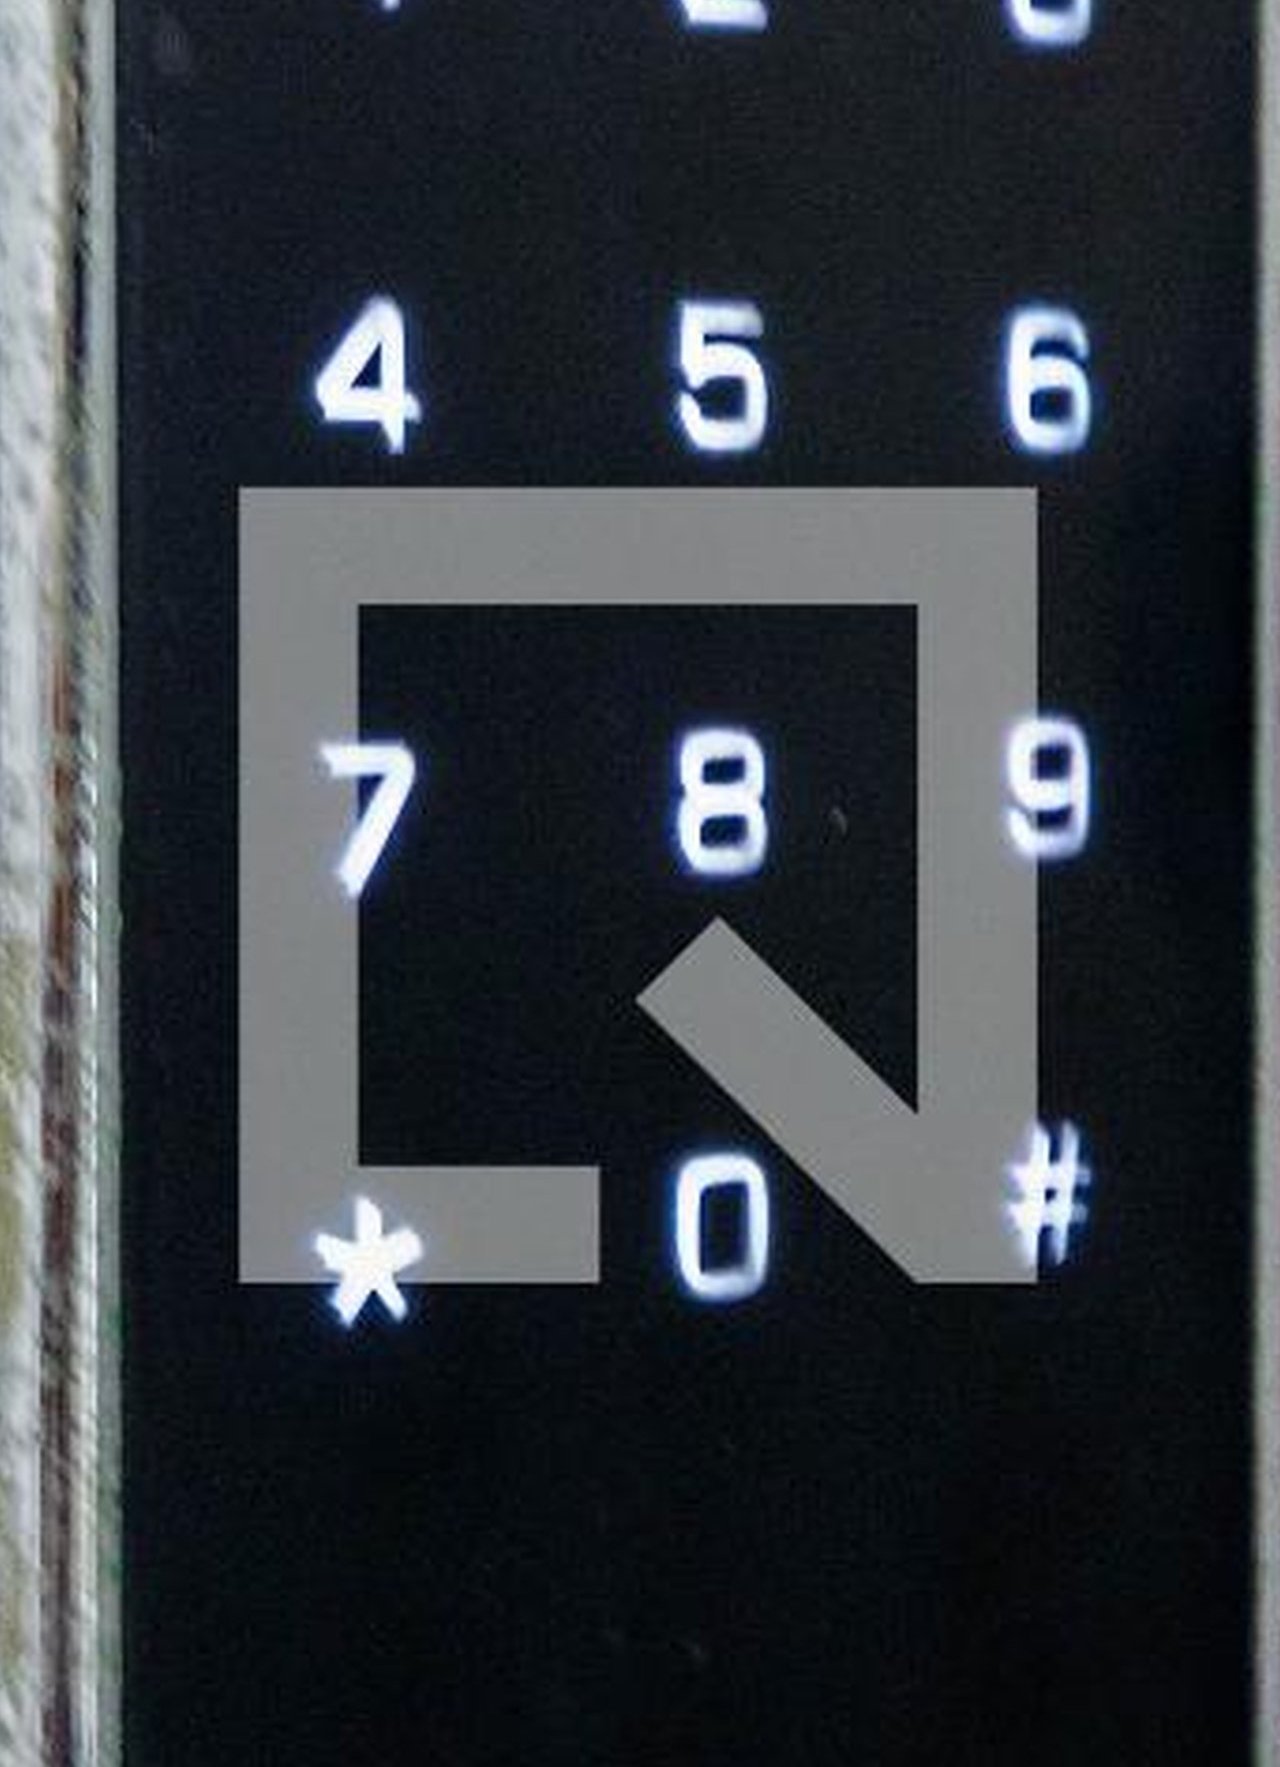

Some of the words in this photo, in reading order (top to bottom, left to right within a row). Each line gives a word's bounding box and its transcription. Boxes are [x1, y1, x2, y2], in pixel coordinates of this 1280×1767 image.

[312, 295, 423, 455] 4
[672, 298, 769, 456] 5
[999, 303, 1095, 456] 6
[317, 736, 417, 901] 7
[672, 725, 769, 878] 8
[998, 712, 1093, 861] 9
[669, 1150, 770, 1301] 0
[999, 1116, 1093, 1269] #
